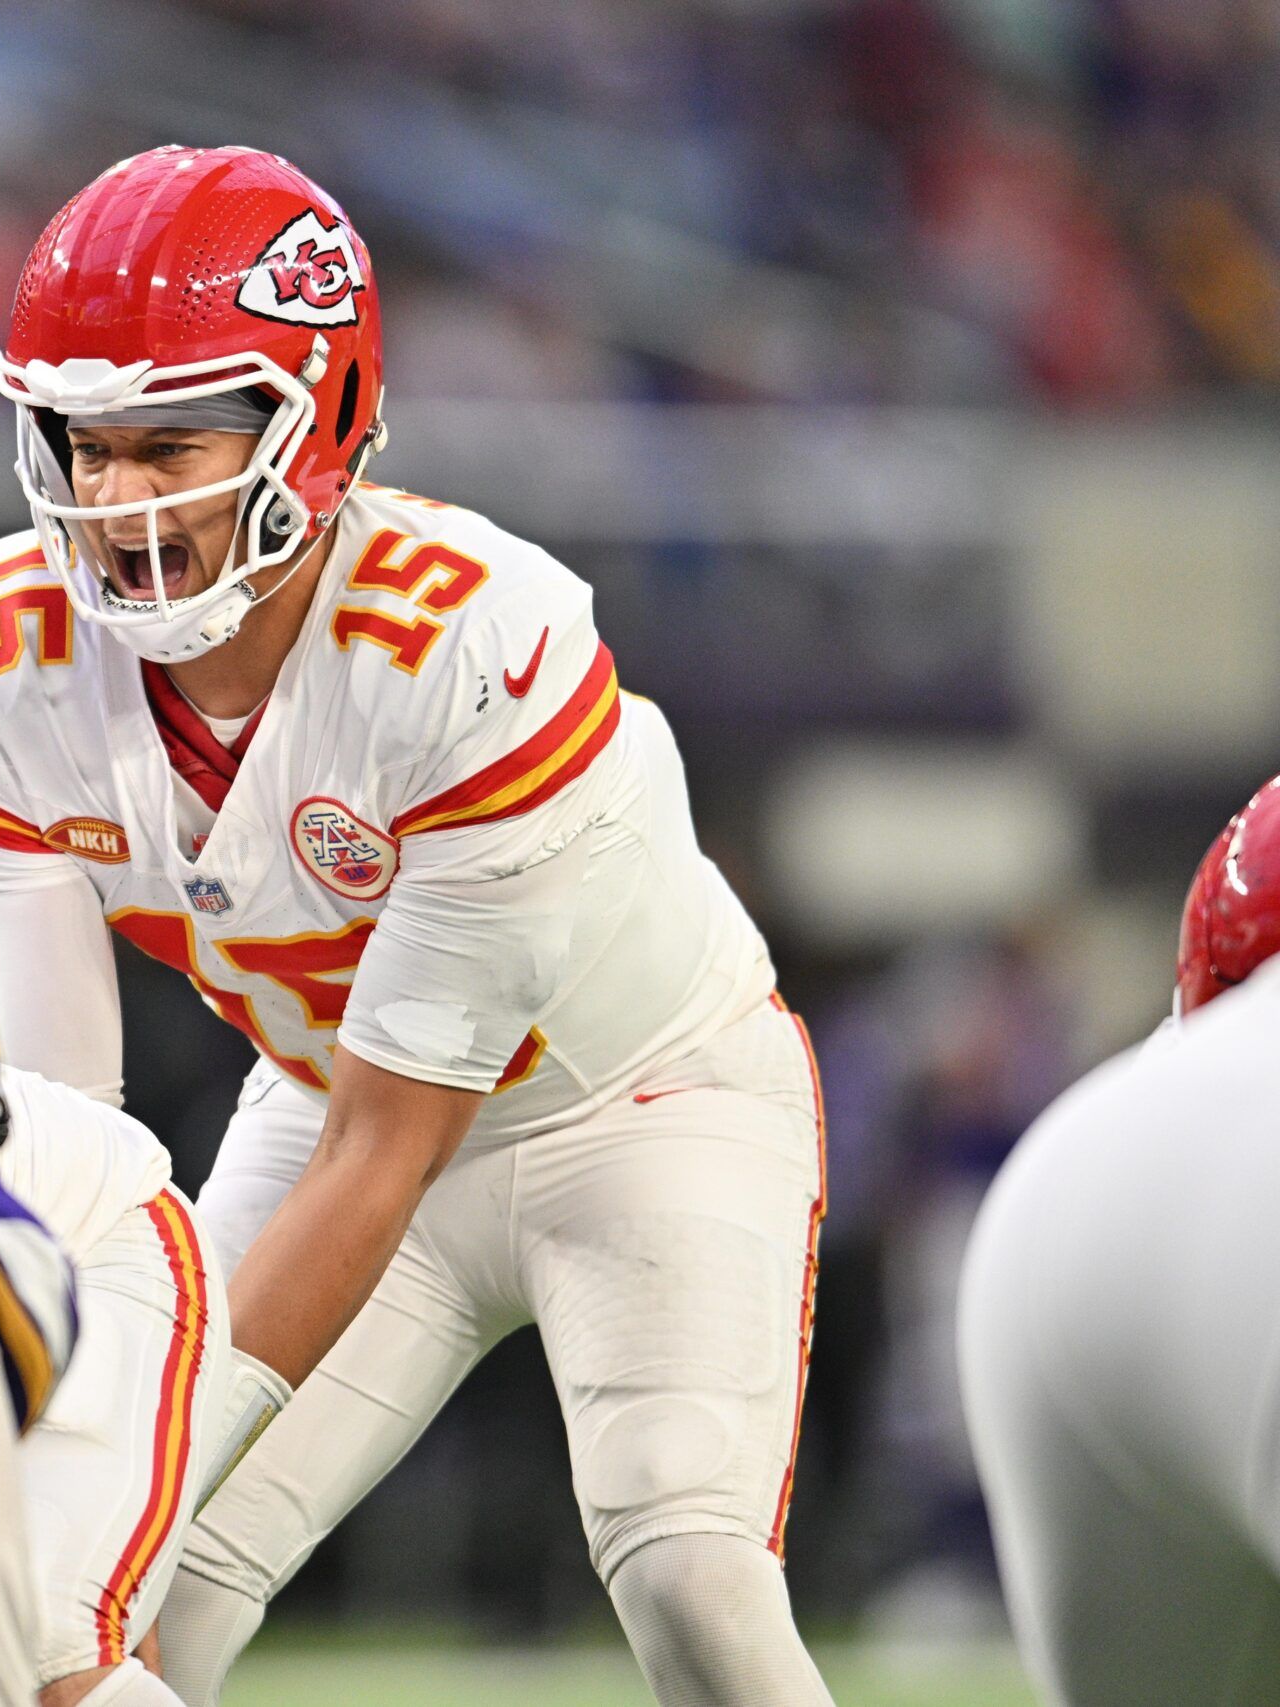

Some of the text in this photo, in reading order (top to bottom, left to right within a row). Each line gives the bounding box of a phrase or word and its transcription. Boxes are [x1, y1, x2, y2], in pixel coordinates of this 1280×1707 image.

[261, 238, 353, 310] KC
[330, 527, 491, 678] 15
[67, 828, 119, 855] NKH
[193, 893, 227, 912] NFL
